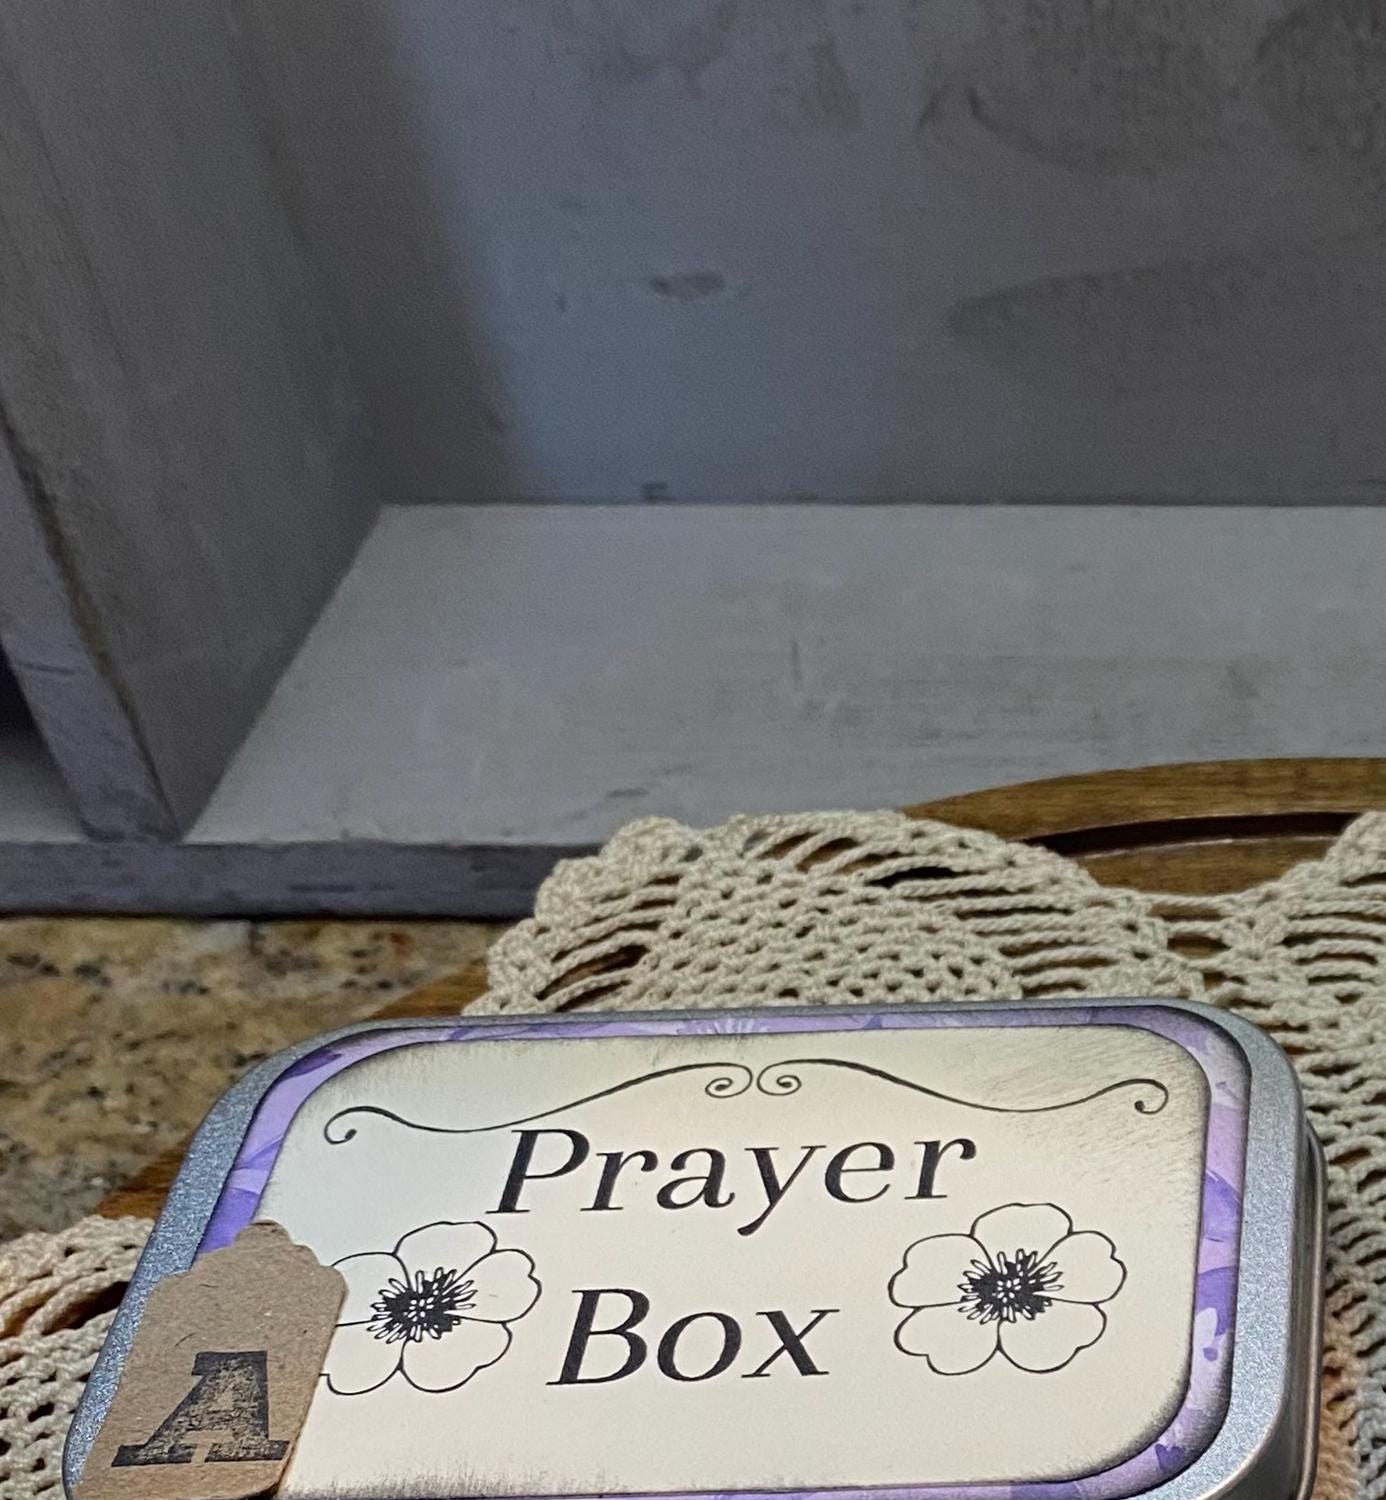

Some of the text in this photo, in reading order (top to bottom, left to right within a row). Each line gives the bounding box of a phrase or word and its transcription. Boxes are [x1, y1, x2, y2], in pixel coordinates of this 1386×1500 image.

[486, 1128, 977, 1237] Prayer
[546, 1288, 841, 1386] Box
[111, 1350, 290, 1468] A
